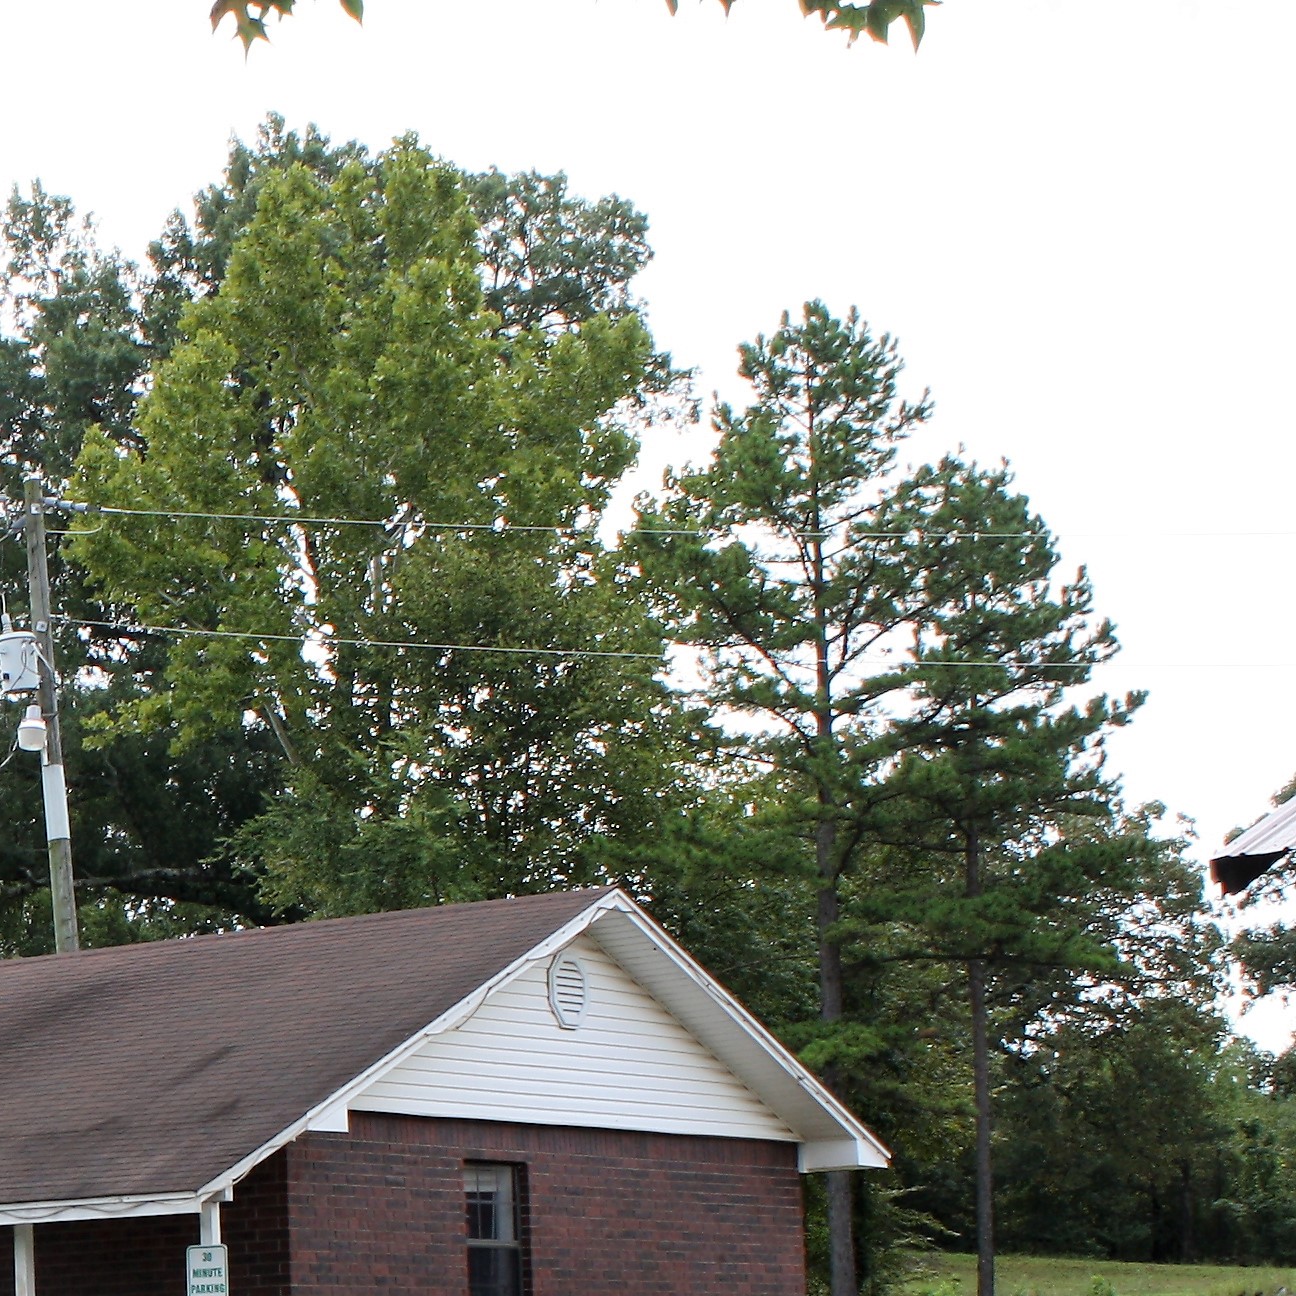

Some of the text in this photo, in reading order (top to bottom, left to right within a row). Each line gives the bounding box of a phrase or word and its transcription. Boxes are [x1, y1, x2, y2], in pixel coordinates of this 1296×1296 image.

[201, 1252, 212, 1262] 30
[192, 1268, 223, 1278] MINUTE
[191, 1283, 226, 1294] PARKING
